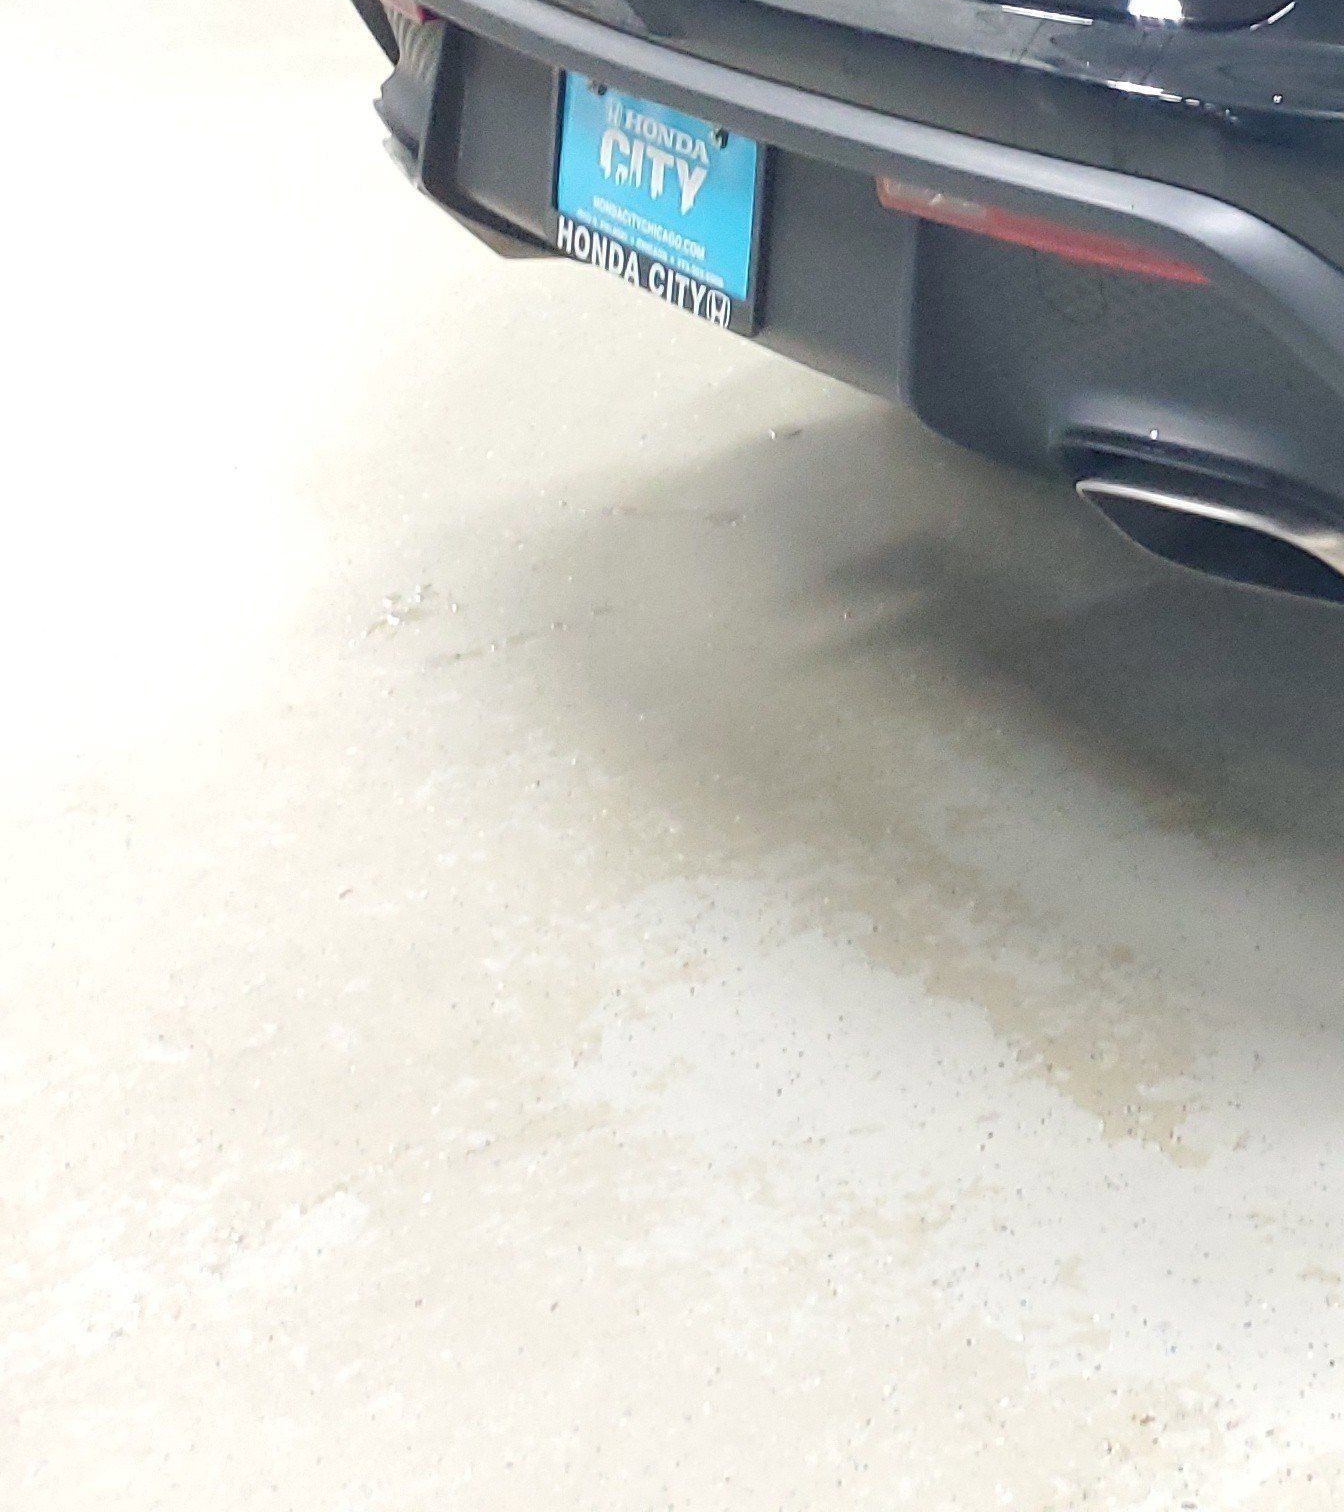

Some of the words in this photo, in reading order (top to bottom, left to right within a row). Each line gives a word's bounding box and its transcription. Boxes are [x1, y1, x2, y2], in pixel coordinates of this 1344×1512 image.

[599, 127, 708, 216] CITY
[625, 109, 710, 167] HONDA
[556, 214, 641, 288] HONDA
[648, 262, 708, 316] CITY
